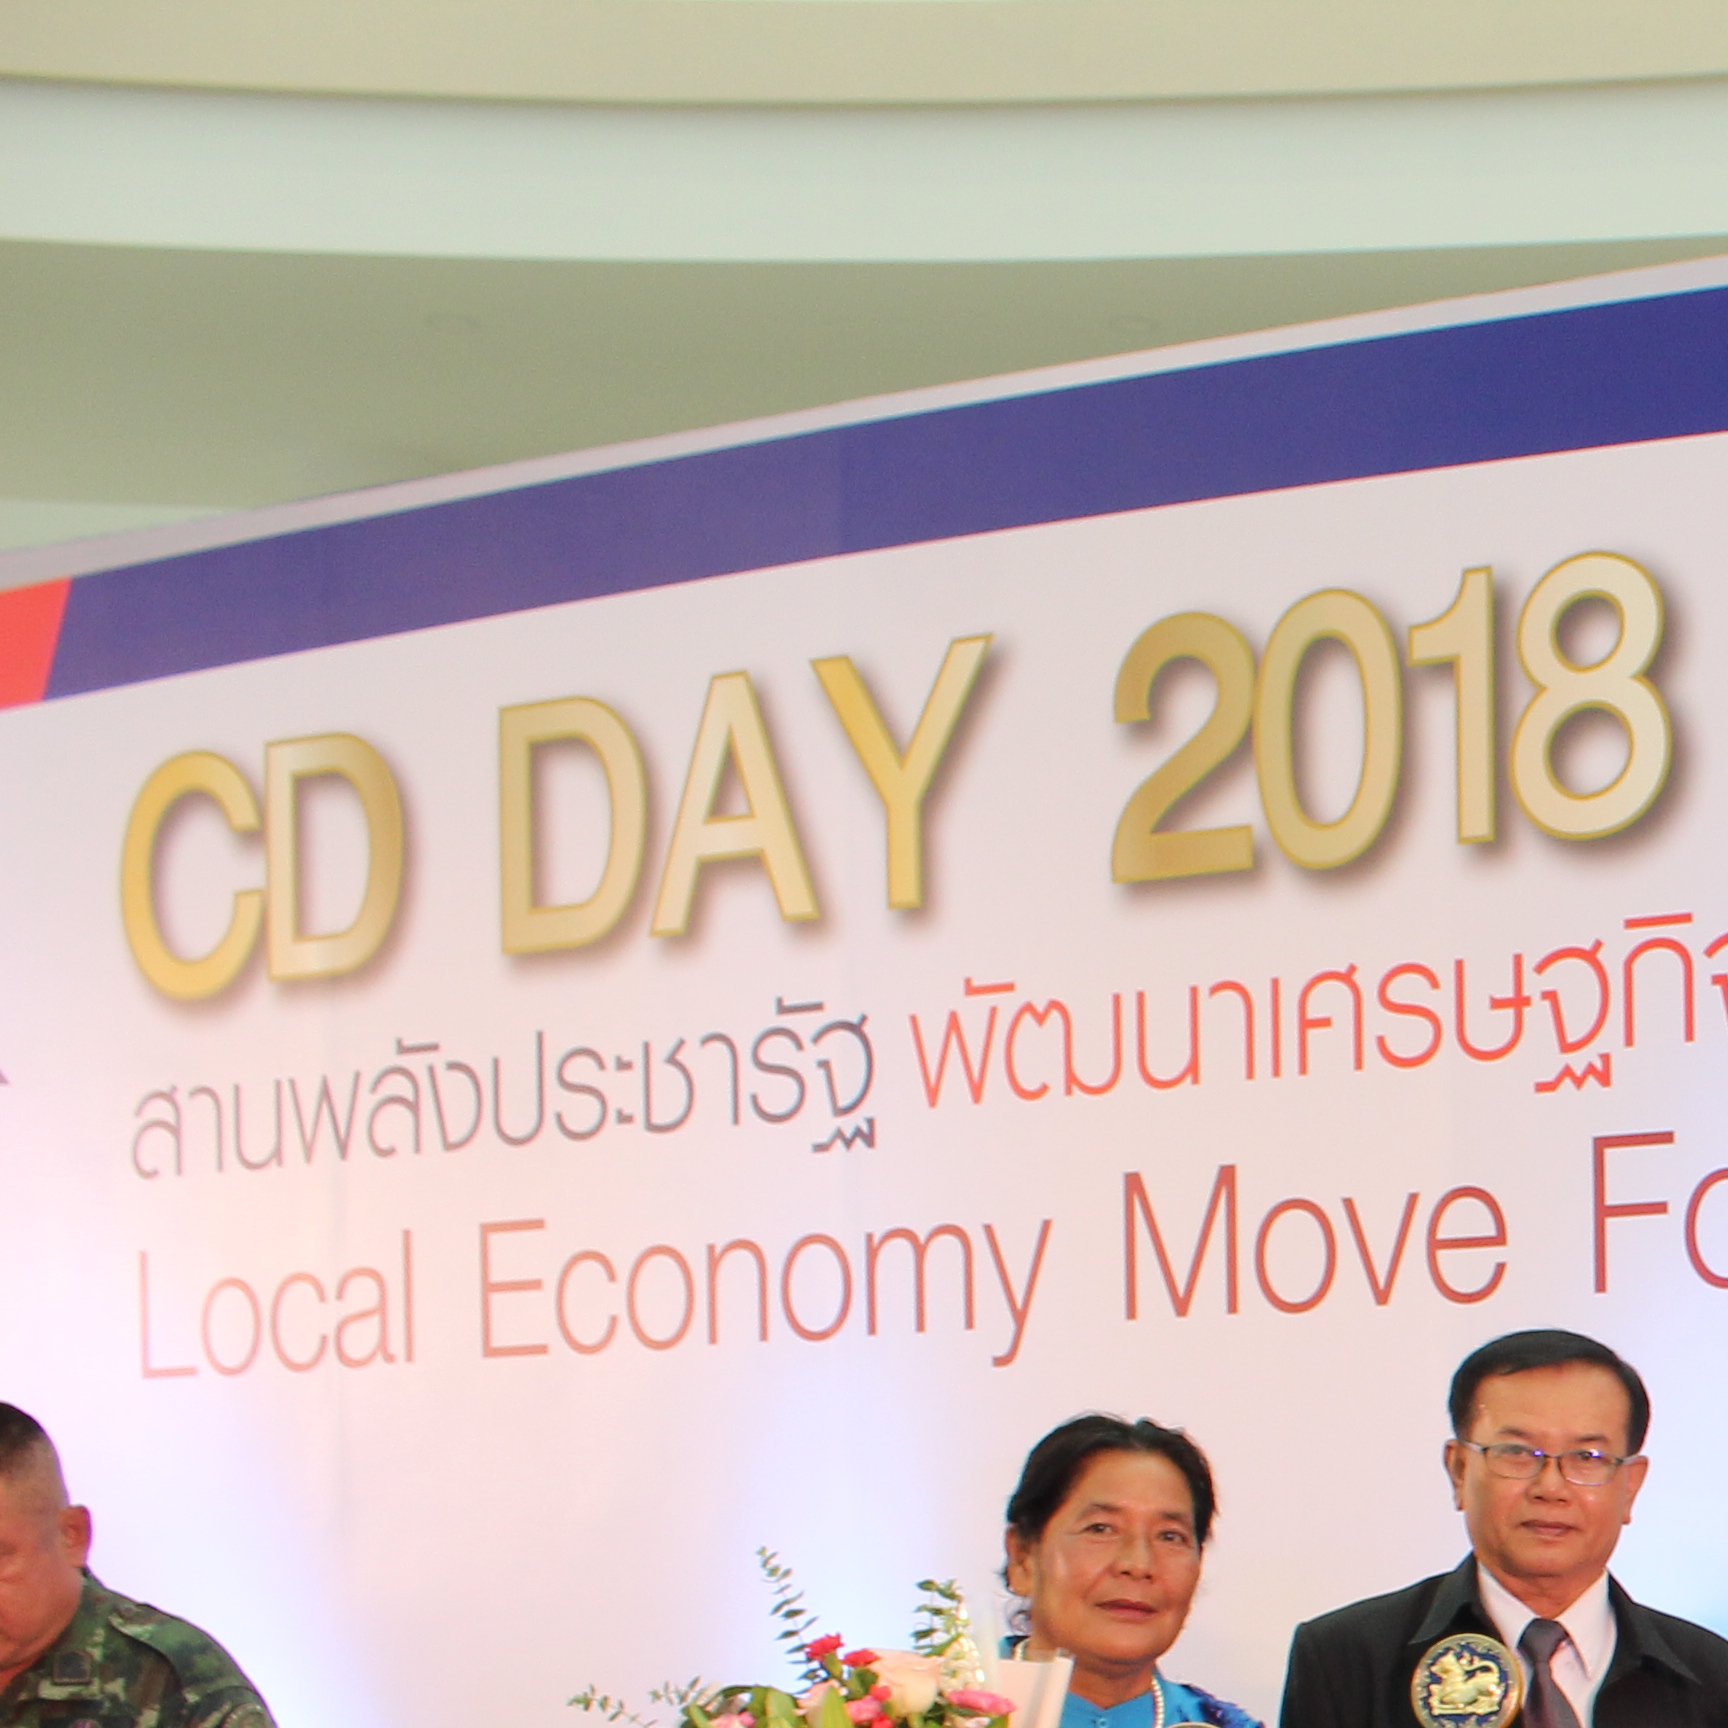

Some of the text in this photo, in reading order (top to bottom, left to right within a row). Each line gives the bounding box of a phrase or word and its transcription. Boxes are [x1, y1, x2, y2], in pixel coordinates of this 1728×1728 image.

[119, 549, 1674, 1001] CD DAY 2018
[131, 997, 876, 1180] สานพลังประชารัฐ
[138, 1229, 416, 1380] Local
[479, 1218, 1053, 1369] Economy
[1122, 1163, 1508, 1321] Move
